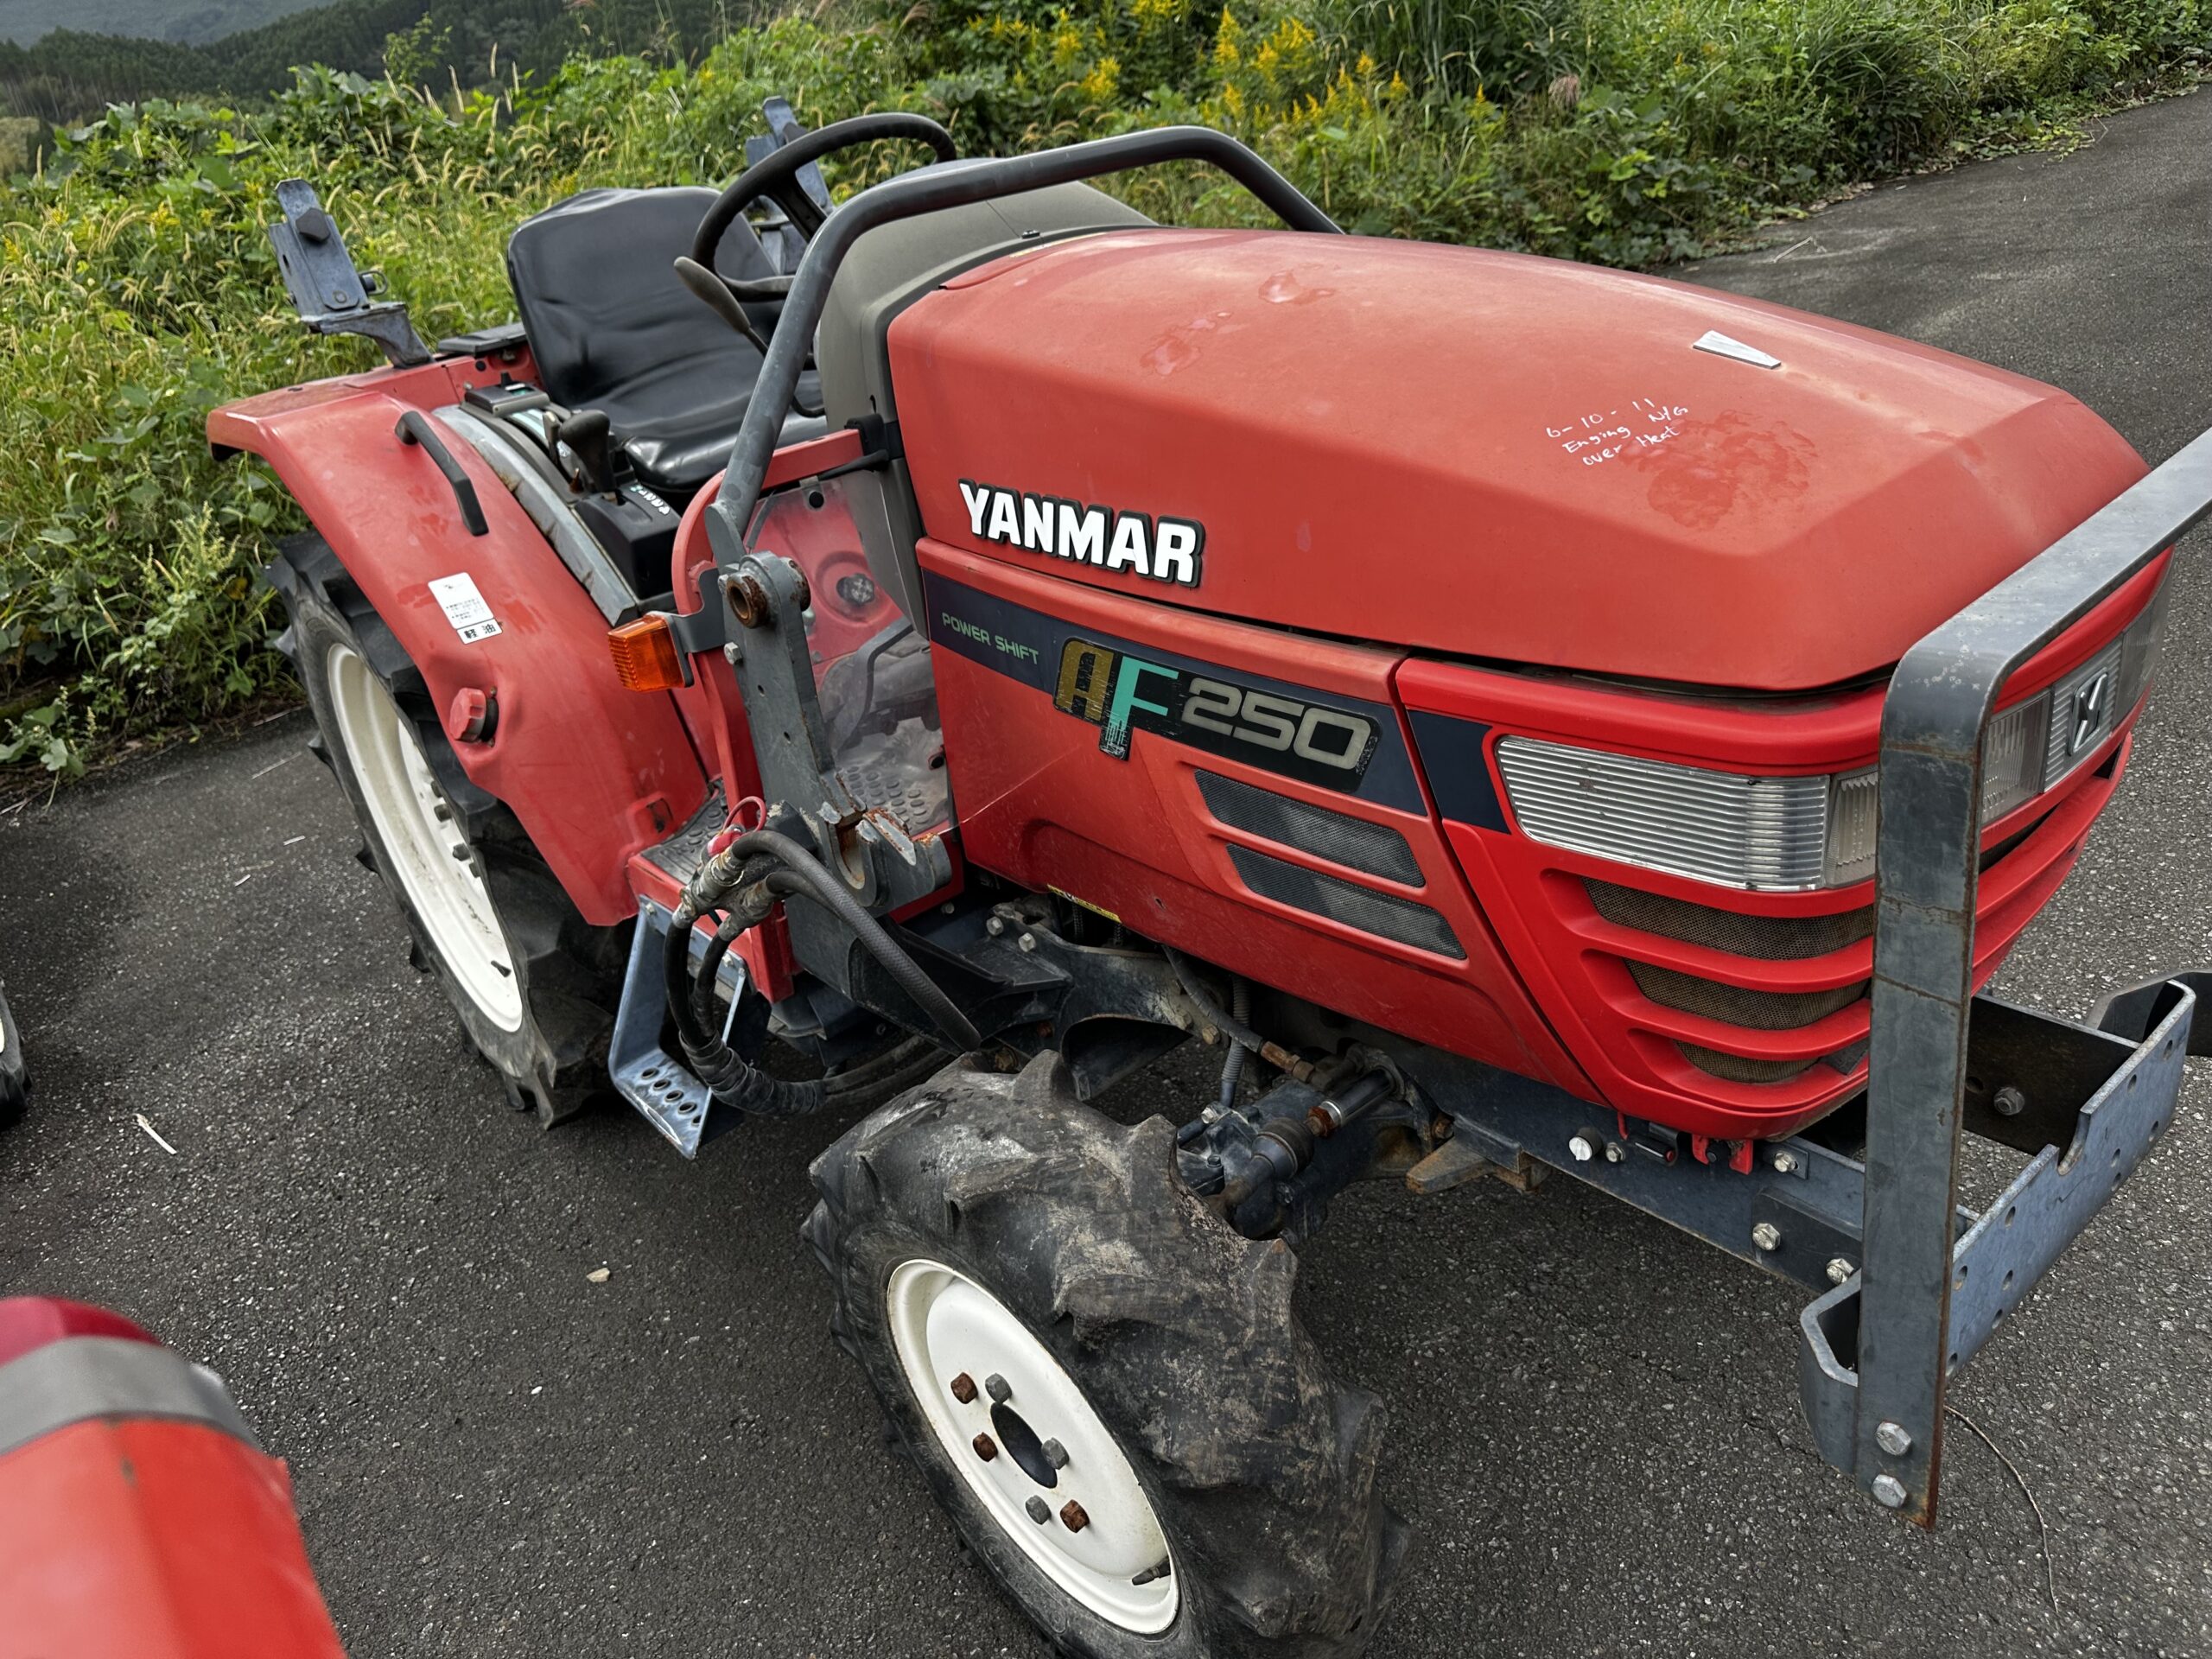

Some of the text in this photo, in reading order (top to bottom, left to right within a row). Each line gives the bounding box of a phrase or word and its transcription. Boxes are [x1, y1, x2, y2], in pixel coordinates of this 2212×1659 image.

[958, 480, 1201, 585] YANMAR
[942, 612, 1039, 664] POWER SHIFT
